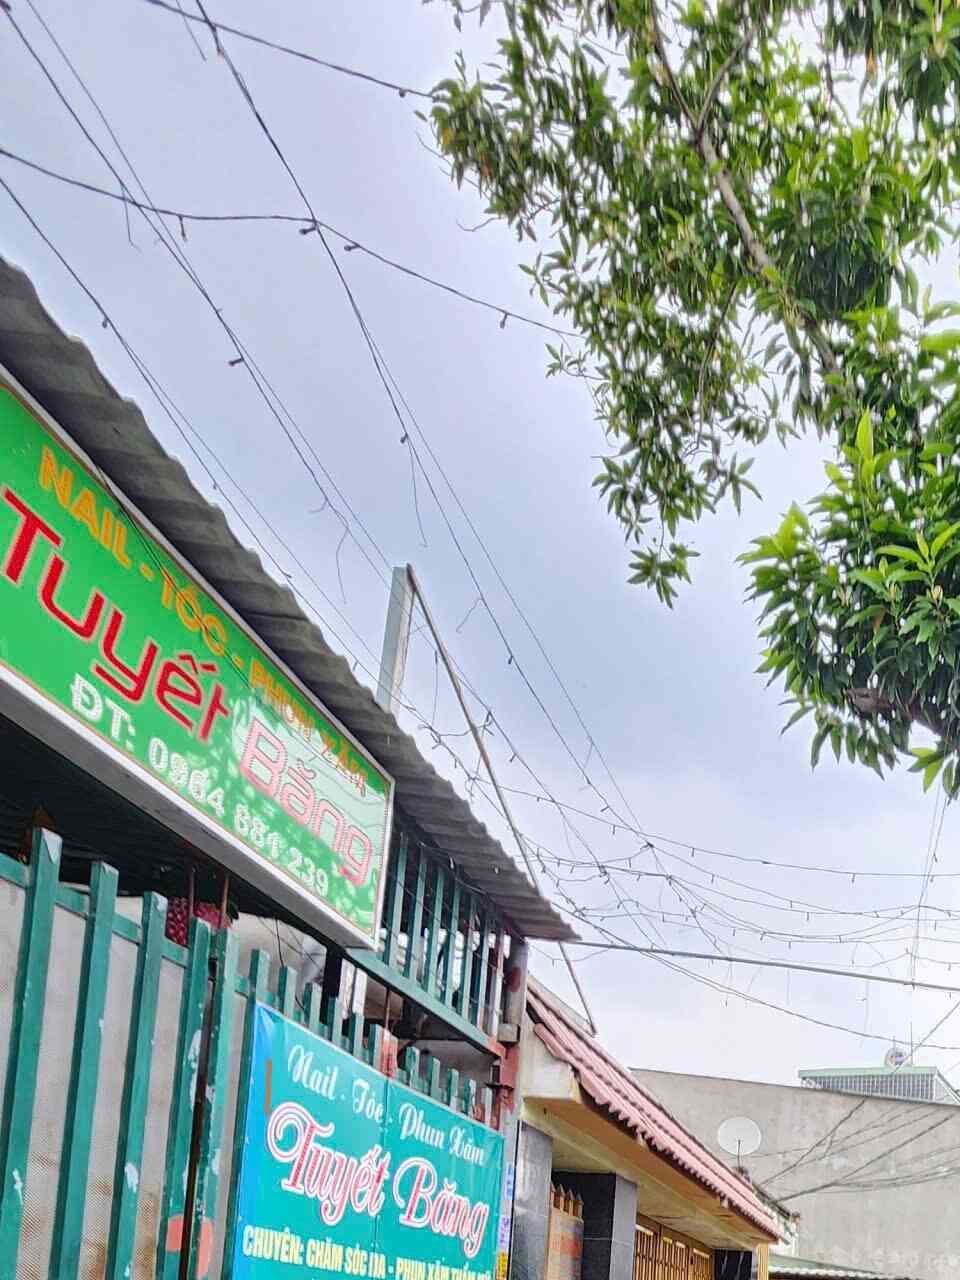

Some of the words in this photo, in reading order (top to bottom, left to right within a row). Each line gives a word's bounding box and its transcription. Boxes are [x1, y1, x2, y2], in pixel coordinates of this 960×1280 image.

[39, 446, 131, 570] NAIL
[161, 567, 227, 656] TÓC
[1, 487, 231, 744] Tuyết
[240, 717, 375, 888] Băng
[72, 673, 136, 754] ĐT:
[287, 1045, 339, 1101] Nail
[399, 1102, 446, 1150] Phun
[449, 1126, 486, 1167] Xăm
[267, 1101, 391, 1226] Tuyết
[392, 1156, 490, 1259] Băng
[242, 1225, 304, 1265] CHUYÊN:
[306, 1237, 343, 1273] CHĂM
[344, 1242, 368, 1277] SÓC
